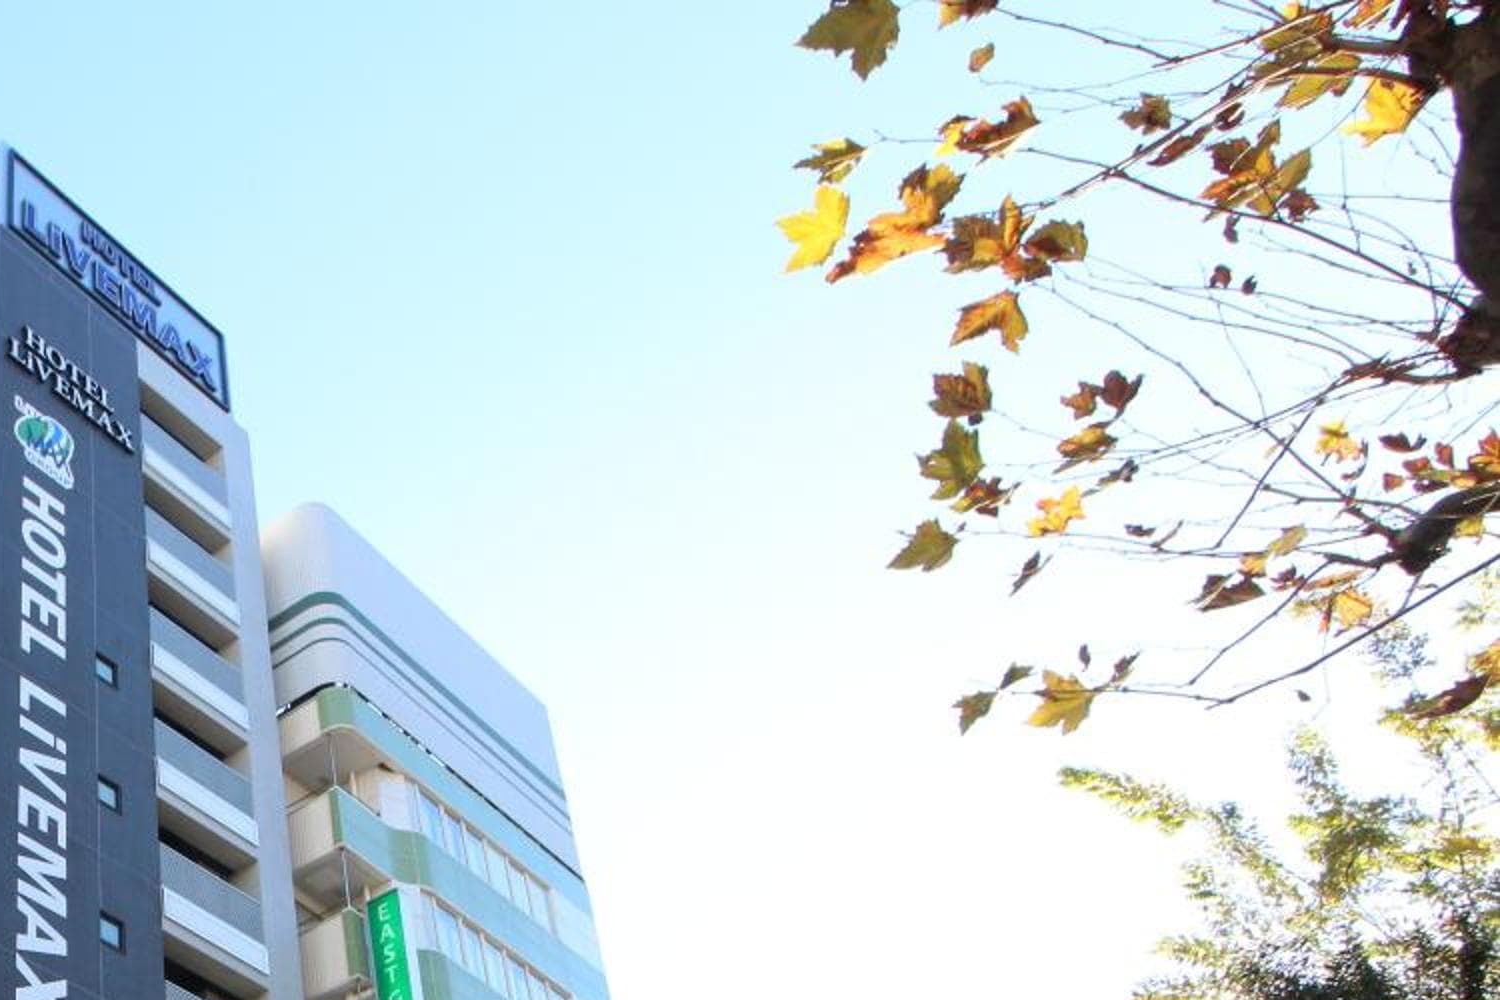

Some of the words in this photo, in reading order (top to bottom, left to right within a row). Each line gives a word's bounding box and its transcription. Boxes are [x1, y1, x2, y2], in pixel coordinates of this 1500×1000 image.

[79, 220, 161, 307] HOTEL
[22, 324, 114, 414] HOTEL
[21, 476, 67, 660] HOTEL
[377, 902, 398, 985] EAST
